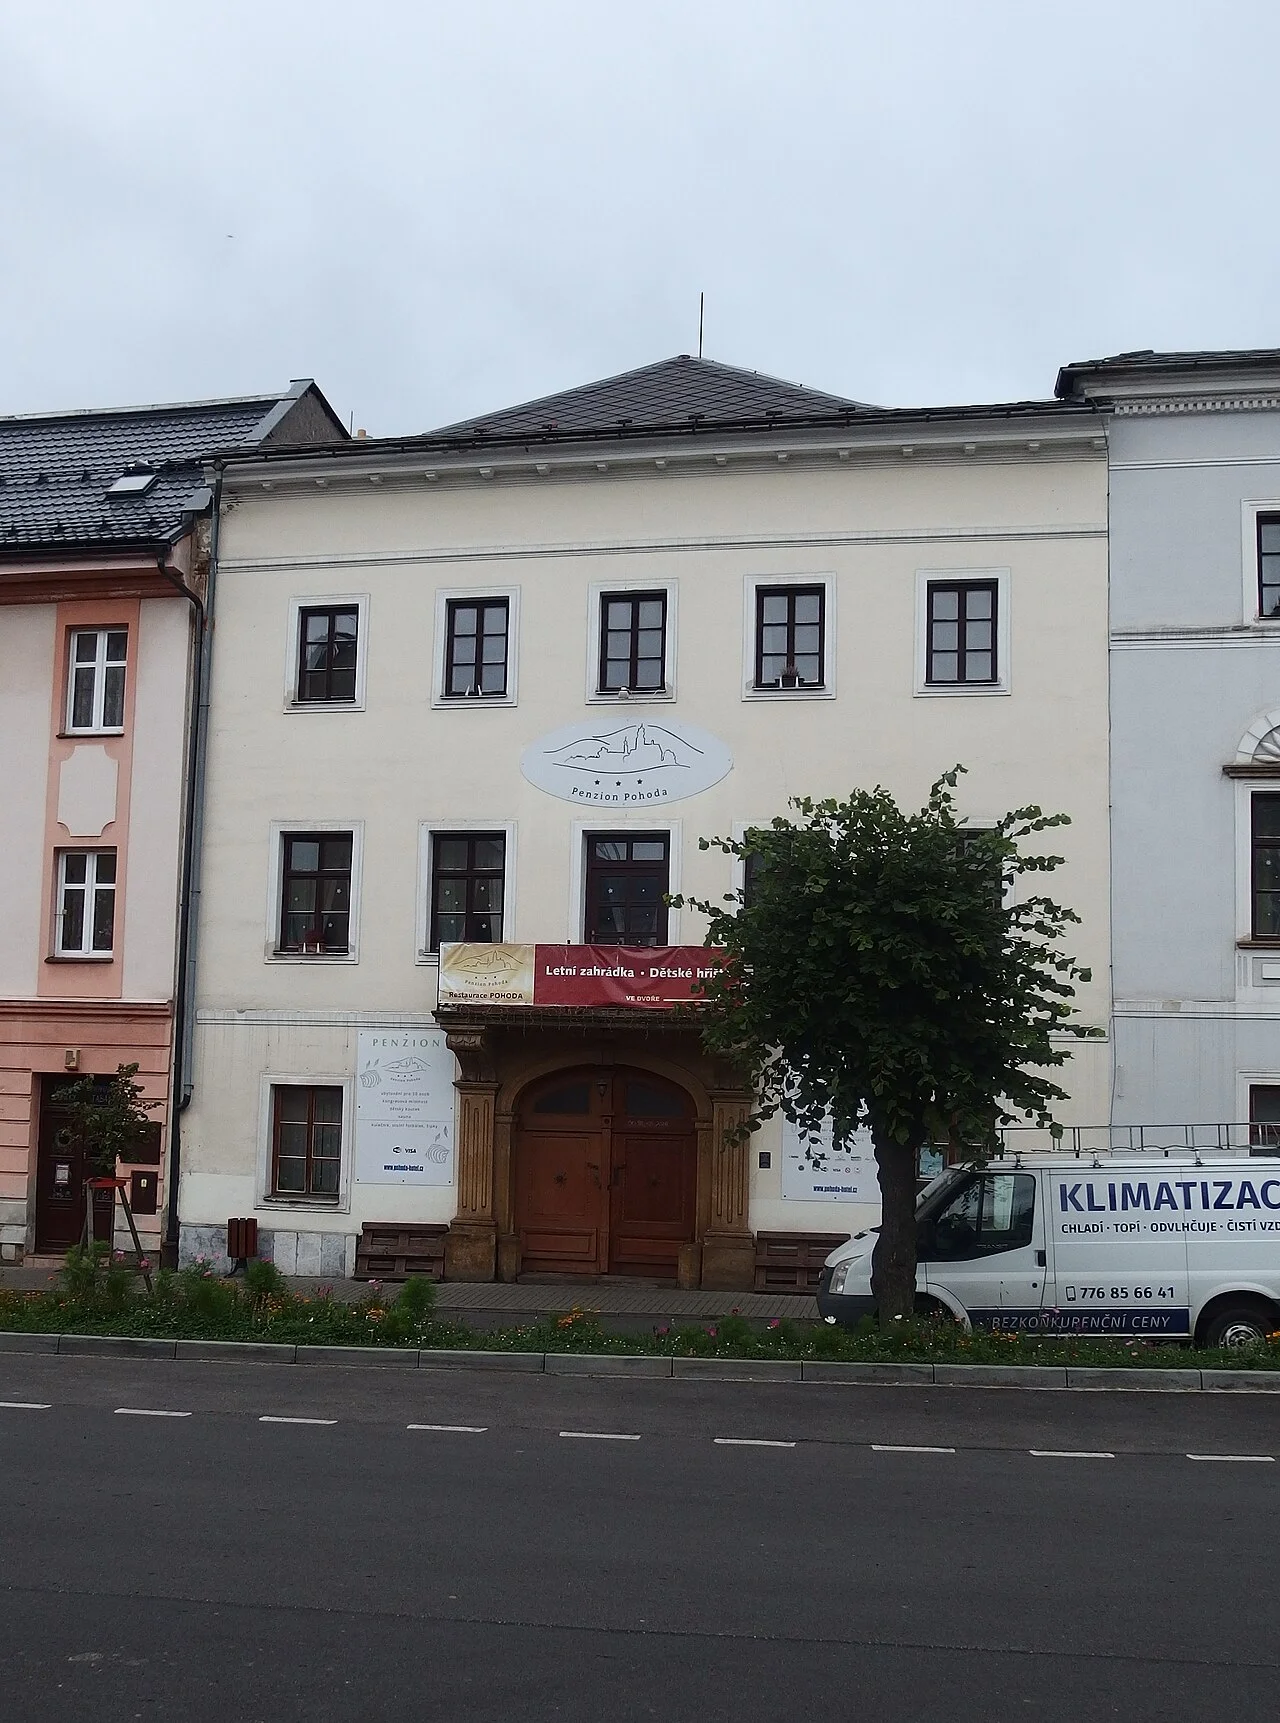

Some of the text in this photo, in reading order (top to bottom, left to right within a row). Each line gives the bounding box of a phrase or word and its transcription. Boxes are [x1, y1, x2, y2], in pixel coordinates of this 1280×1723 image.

[572, 787, 668, 801] Penzion Pohoda
[546, 964, 577, 977] Letní
[580, 965, 635, 979] zahrádka
[649, 966, 693, 979] Dětské
[448, 991, 523, 1000] Restaurace POHODA
[372, 1038, 440, 1048] PENZION
[383, 1164, 424, 1172] www.pohoda-hotel.cz
[813, 1185, 858, 1193] www.pohoda-hotel.cz
[1061, 1221, 1104, 1234] CHLADÍ
[1113, 1220, 1140, 1233] TOPÍ
[1150, 1219, 1217, 1234] ODVLHČUJE
[1227, 1218, 1257, 1232] ČISTÍ
[1080, 1286, 1175, 1299] 776 85 66 41
[1131, 1315, 1171, 1329] CENY
